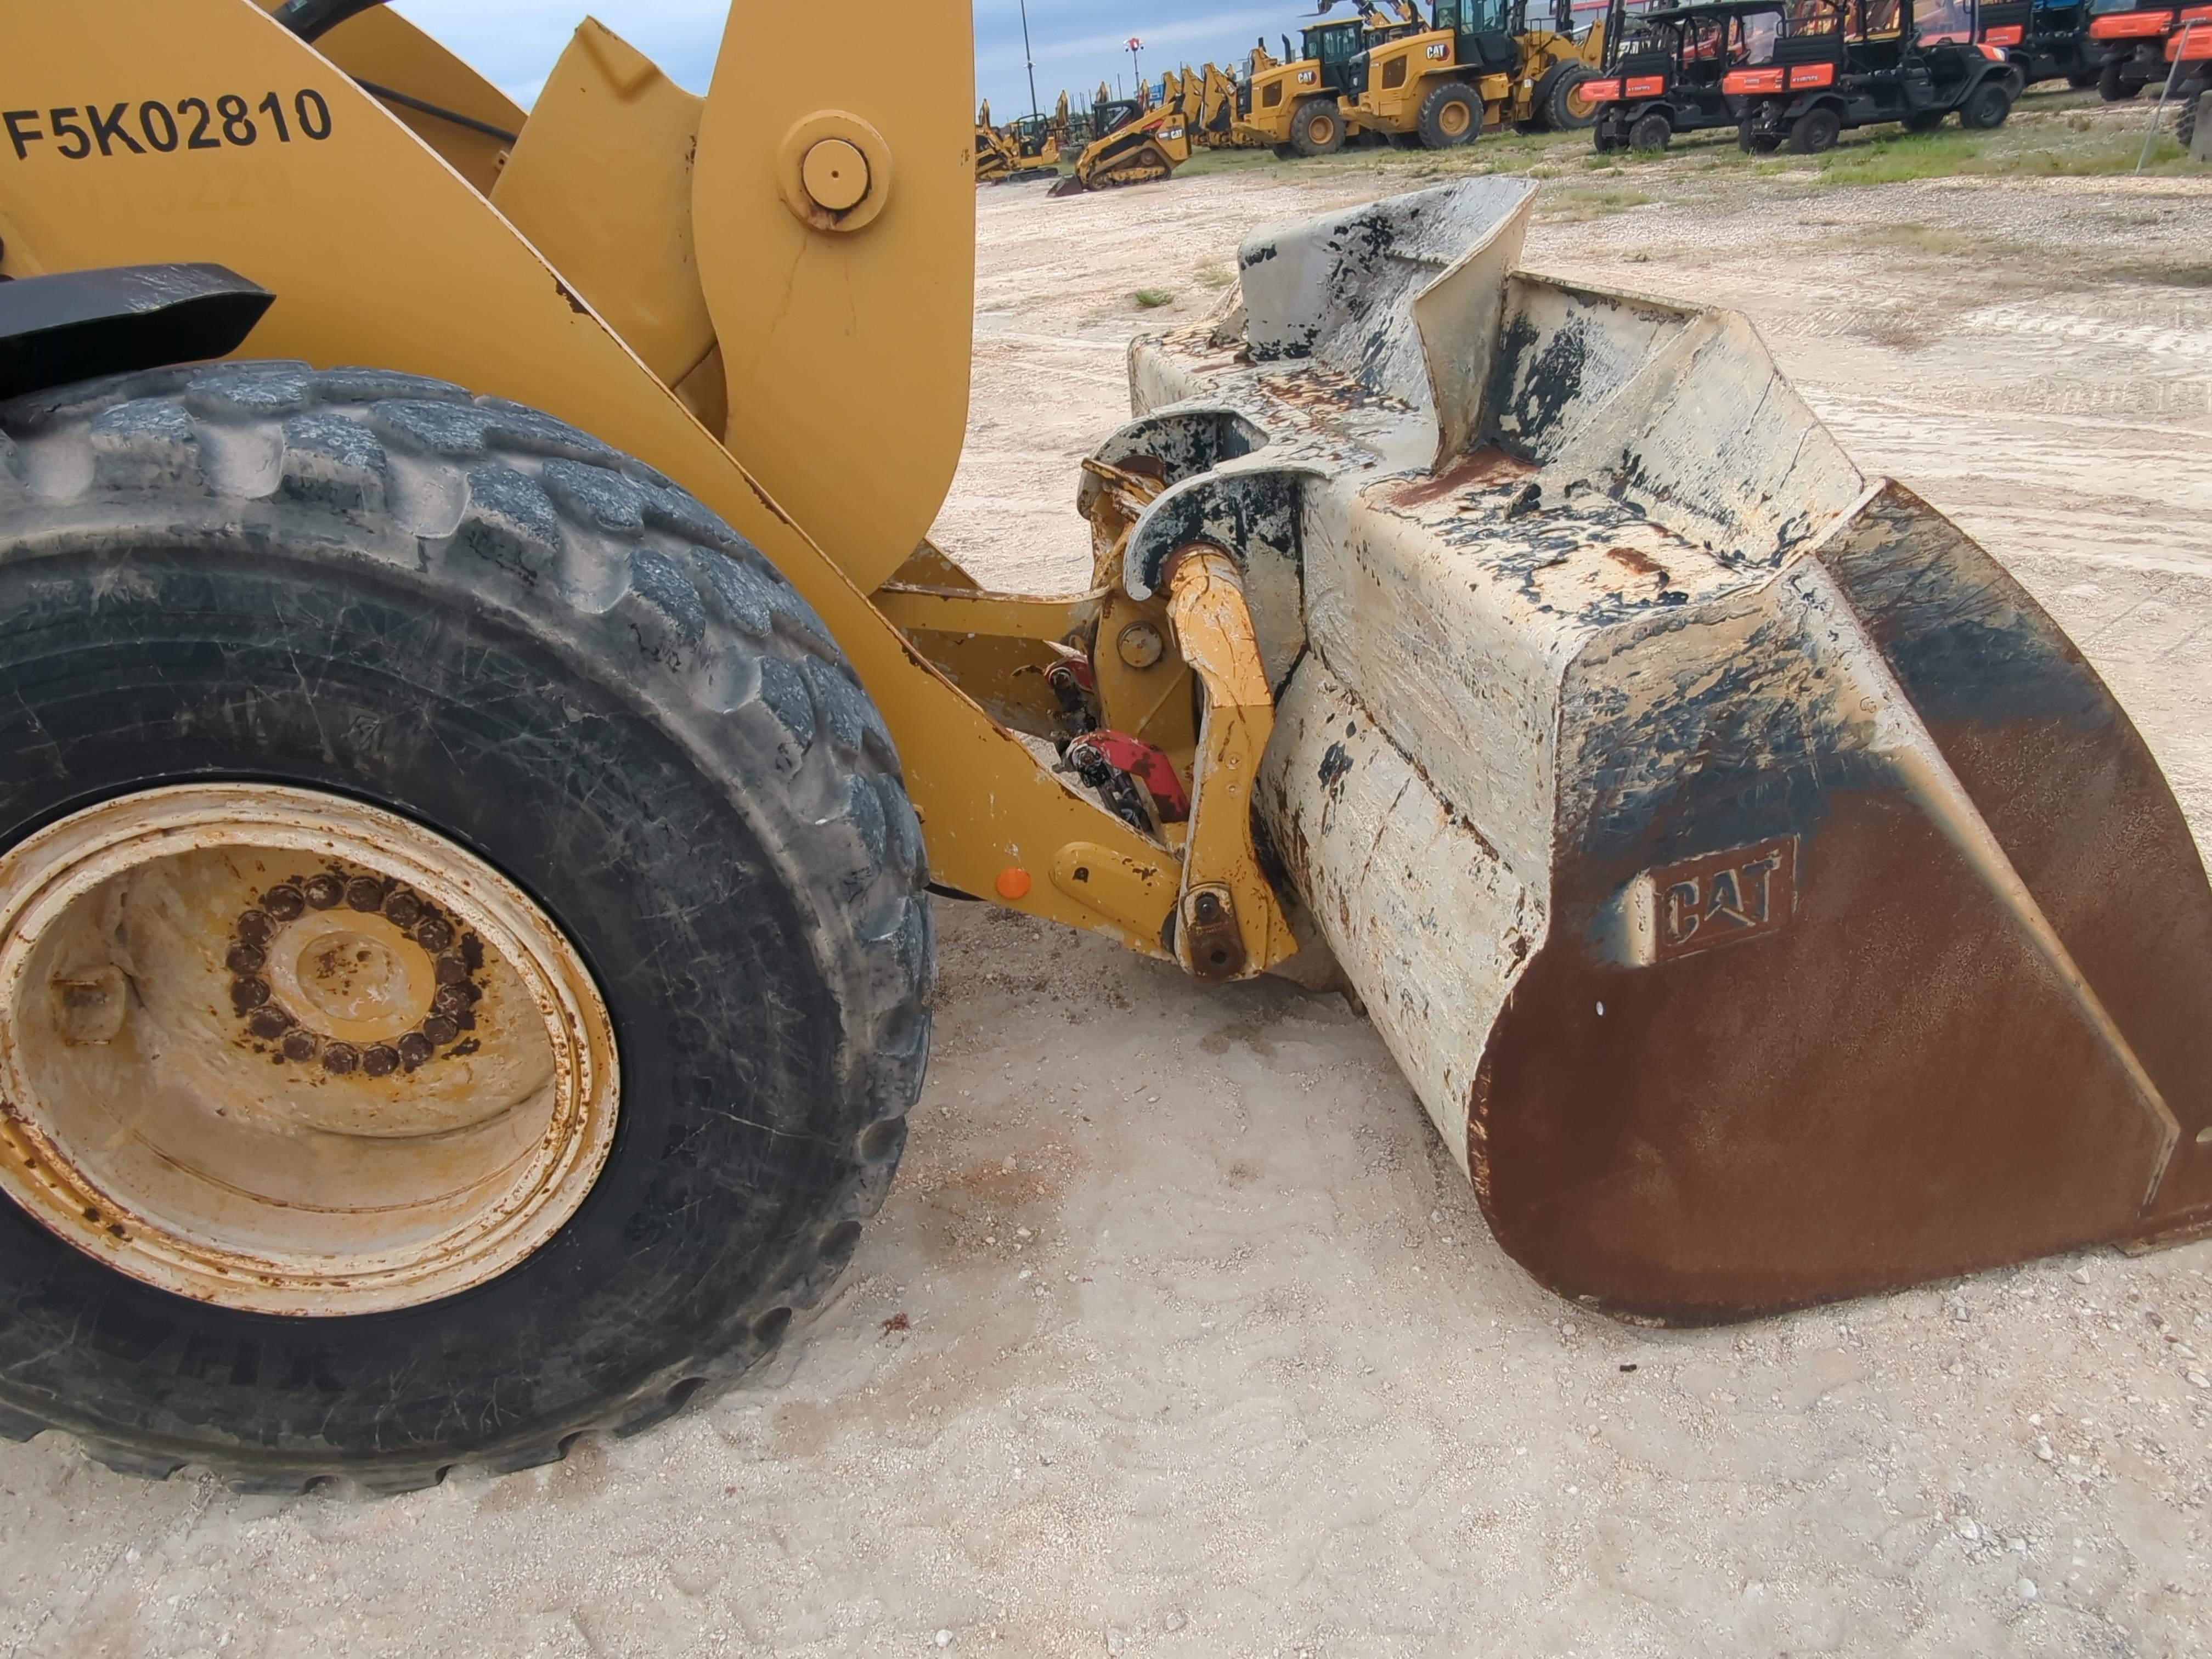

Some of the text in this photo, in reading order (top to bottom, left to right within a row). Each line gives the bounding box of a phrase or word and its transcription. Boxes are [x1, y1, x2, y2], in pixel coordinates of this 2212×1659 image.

[1426, 44, 1444, 59] CAT
[1297, 71, 1312, 84] CAT
[2, 88, 332, 161] F5K02810
[1662, 850, 1783, 947] CAT
